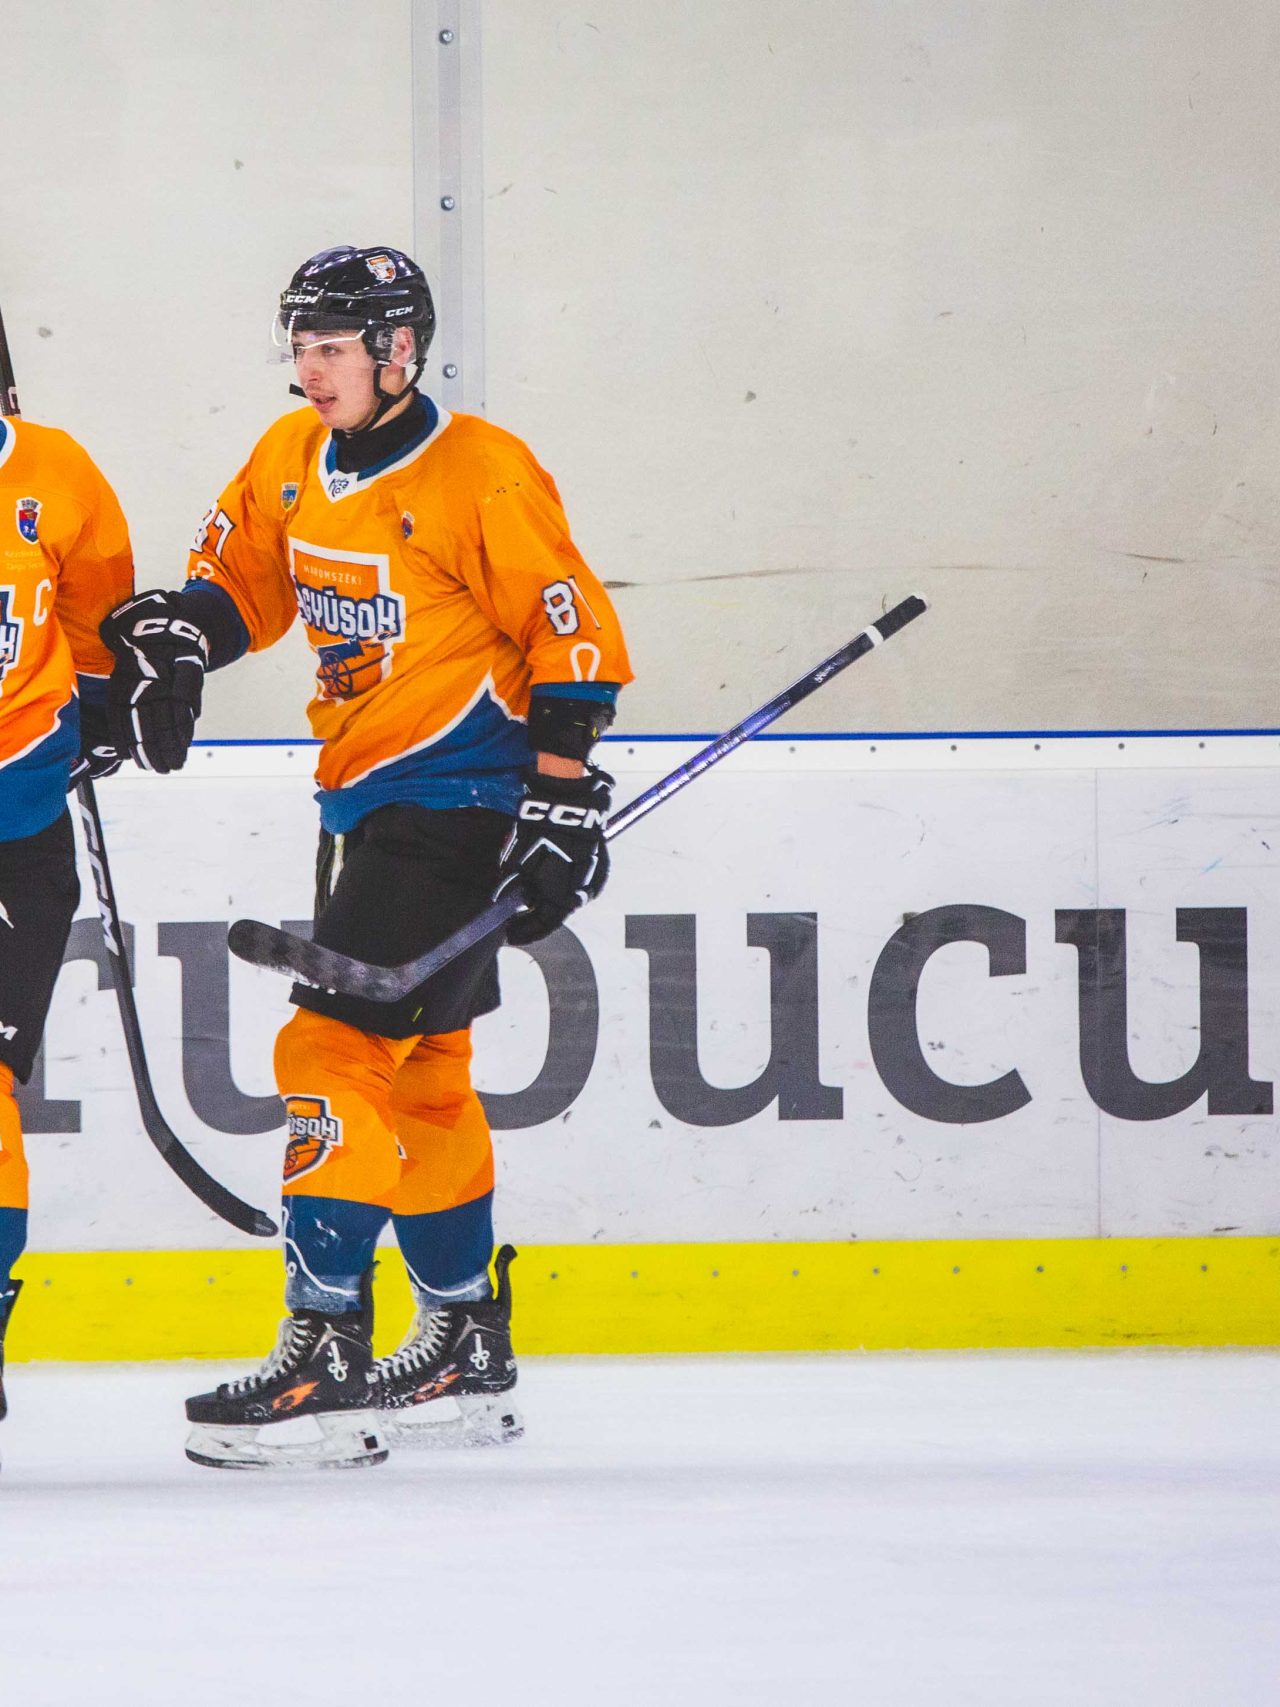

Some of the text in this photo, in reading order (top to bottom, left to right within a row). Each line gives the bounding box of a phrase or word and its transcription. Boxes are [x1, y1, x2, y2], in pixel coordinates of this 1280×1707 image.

[286, 295, 319, 304] CCM
[384, 306, 414, 318] CCM
[32, 578, 53, 627] C
[519, 800, 608, 830] CCM
